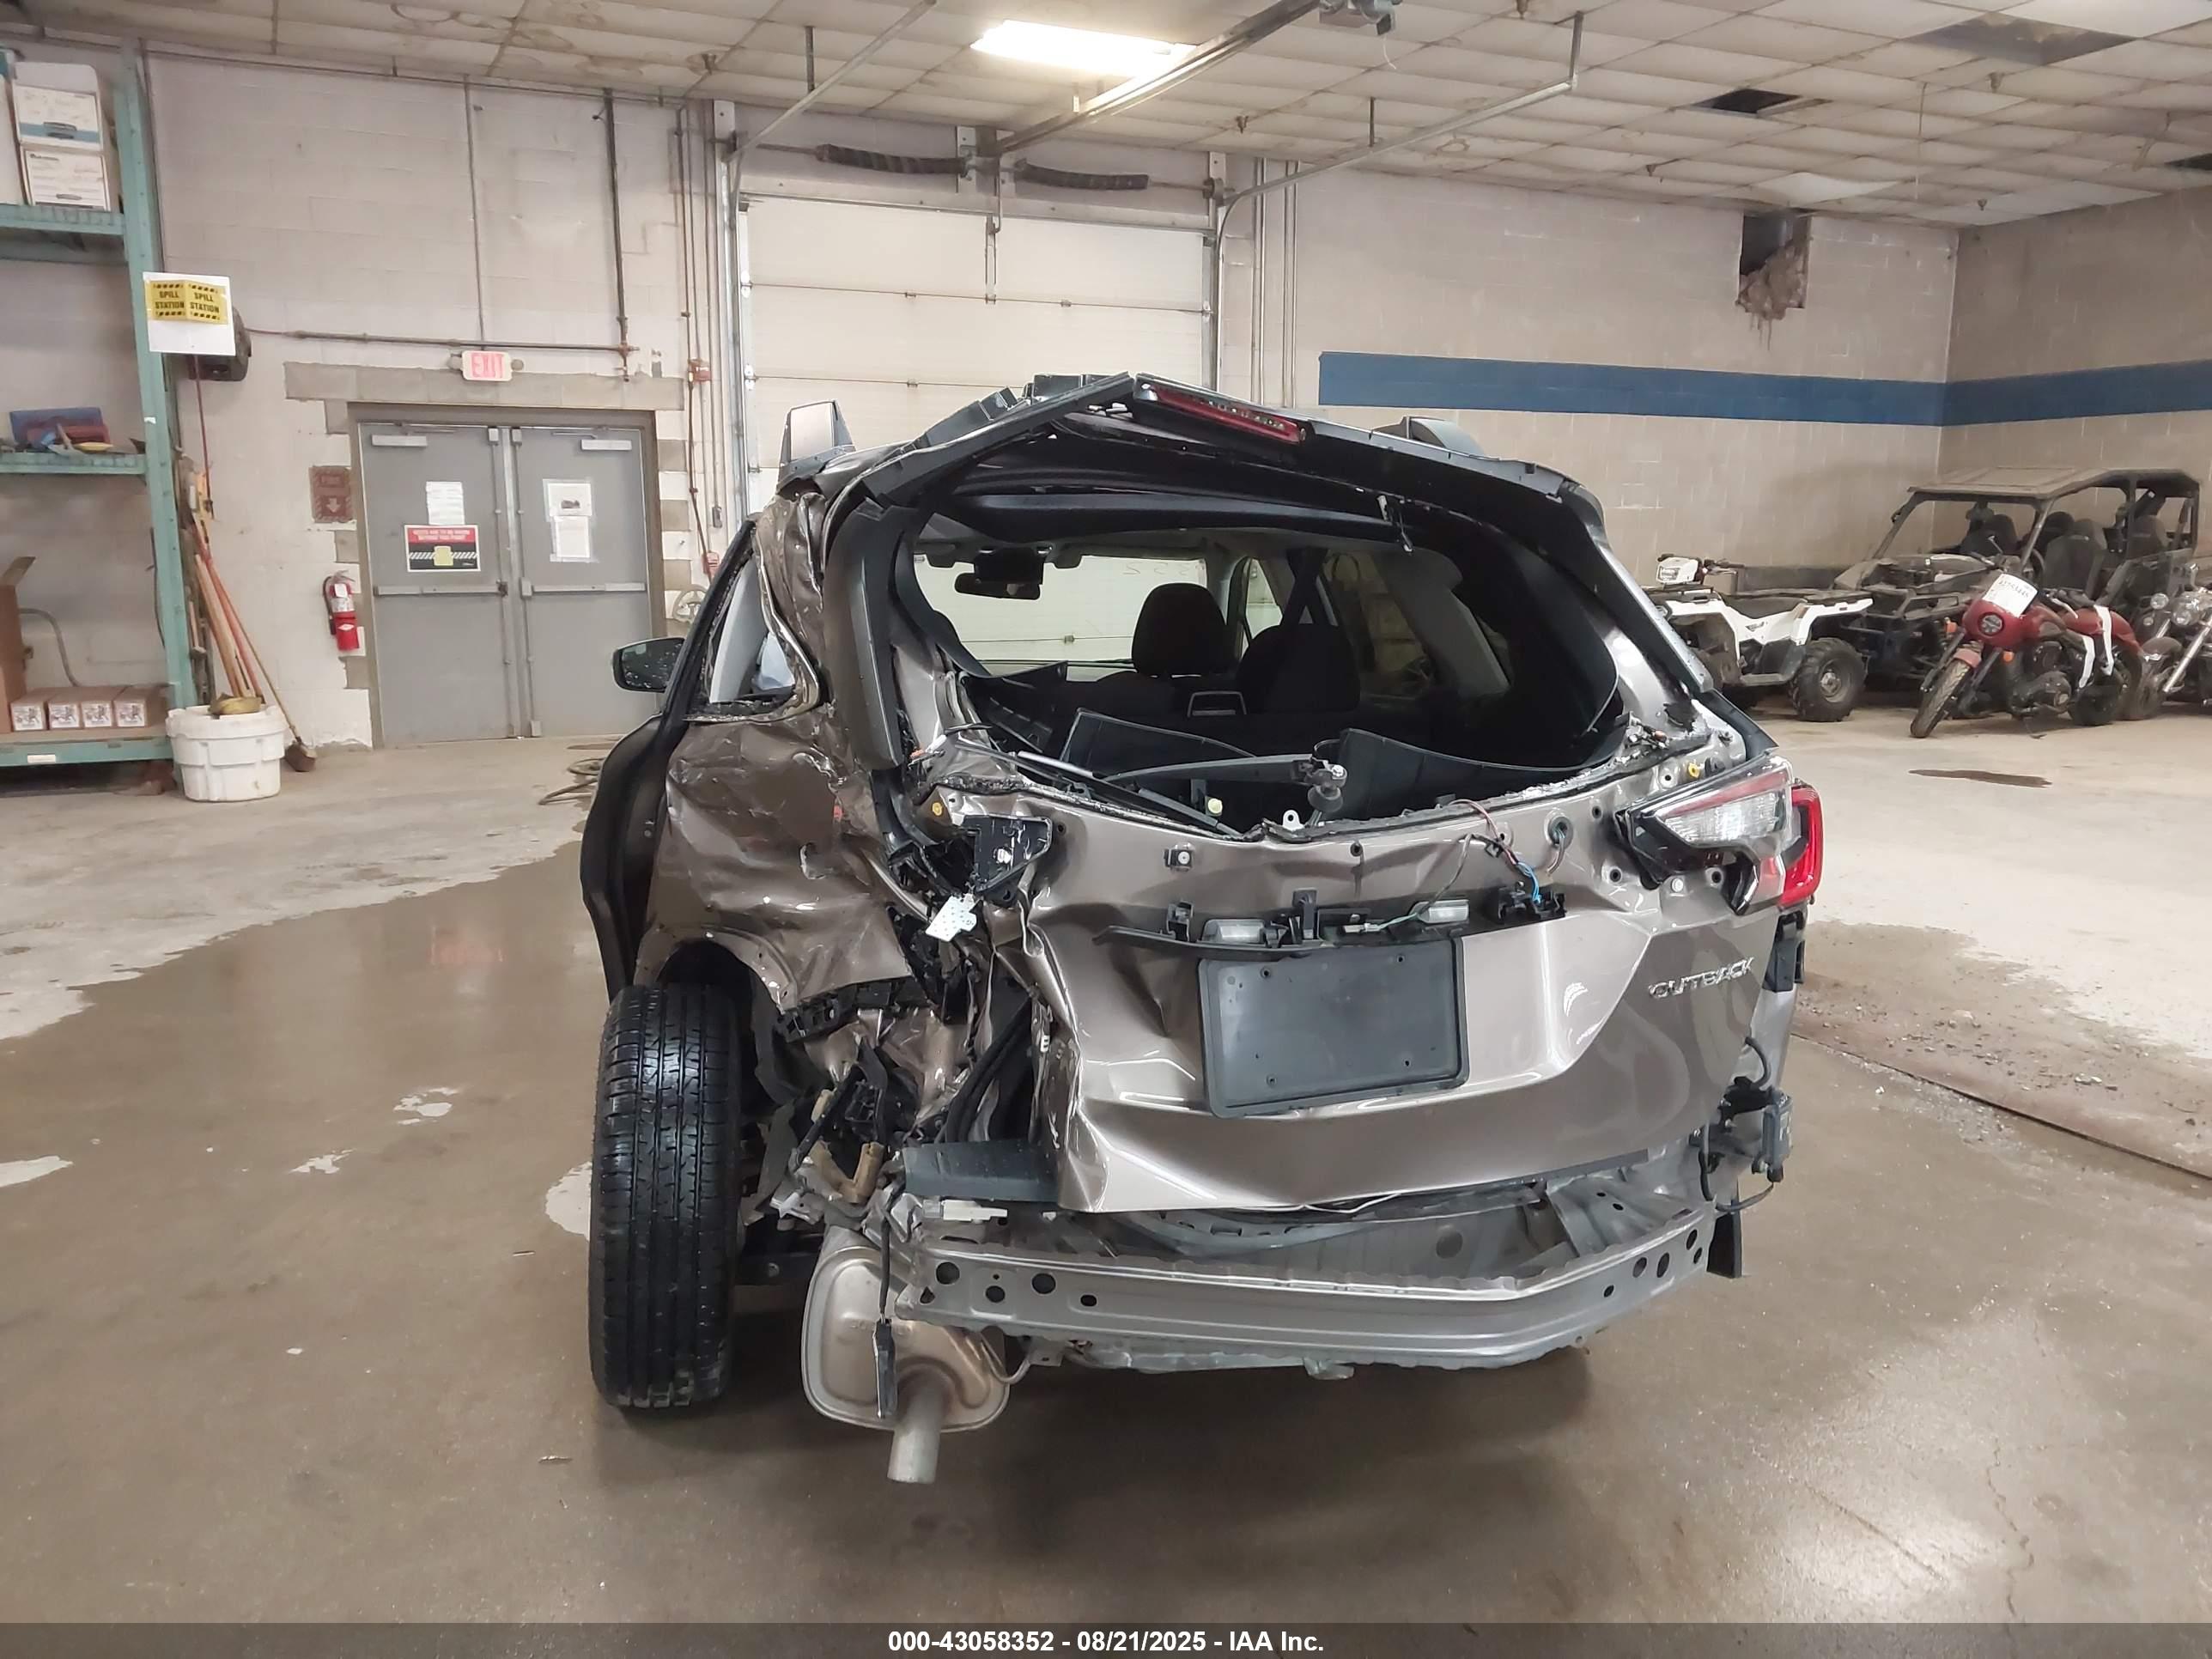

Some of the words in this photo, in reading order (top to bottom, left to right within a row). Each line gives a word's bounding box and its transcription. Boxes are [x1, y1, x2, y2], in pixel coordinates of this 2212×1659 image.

[194, 292, 214, 302] SPILL
[155, 301, 185, 310] STATION
[190, 302, 220, 313] STATION
[472, 353, 504, 379] EXIT
[1648, 957, 1753, 999] OUTBACK
